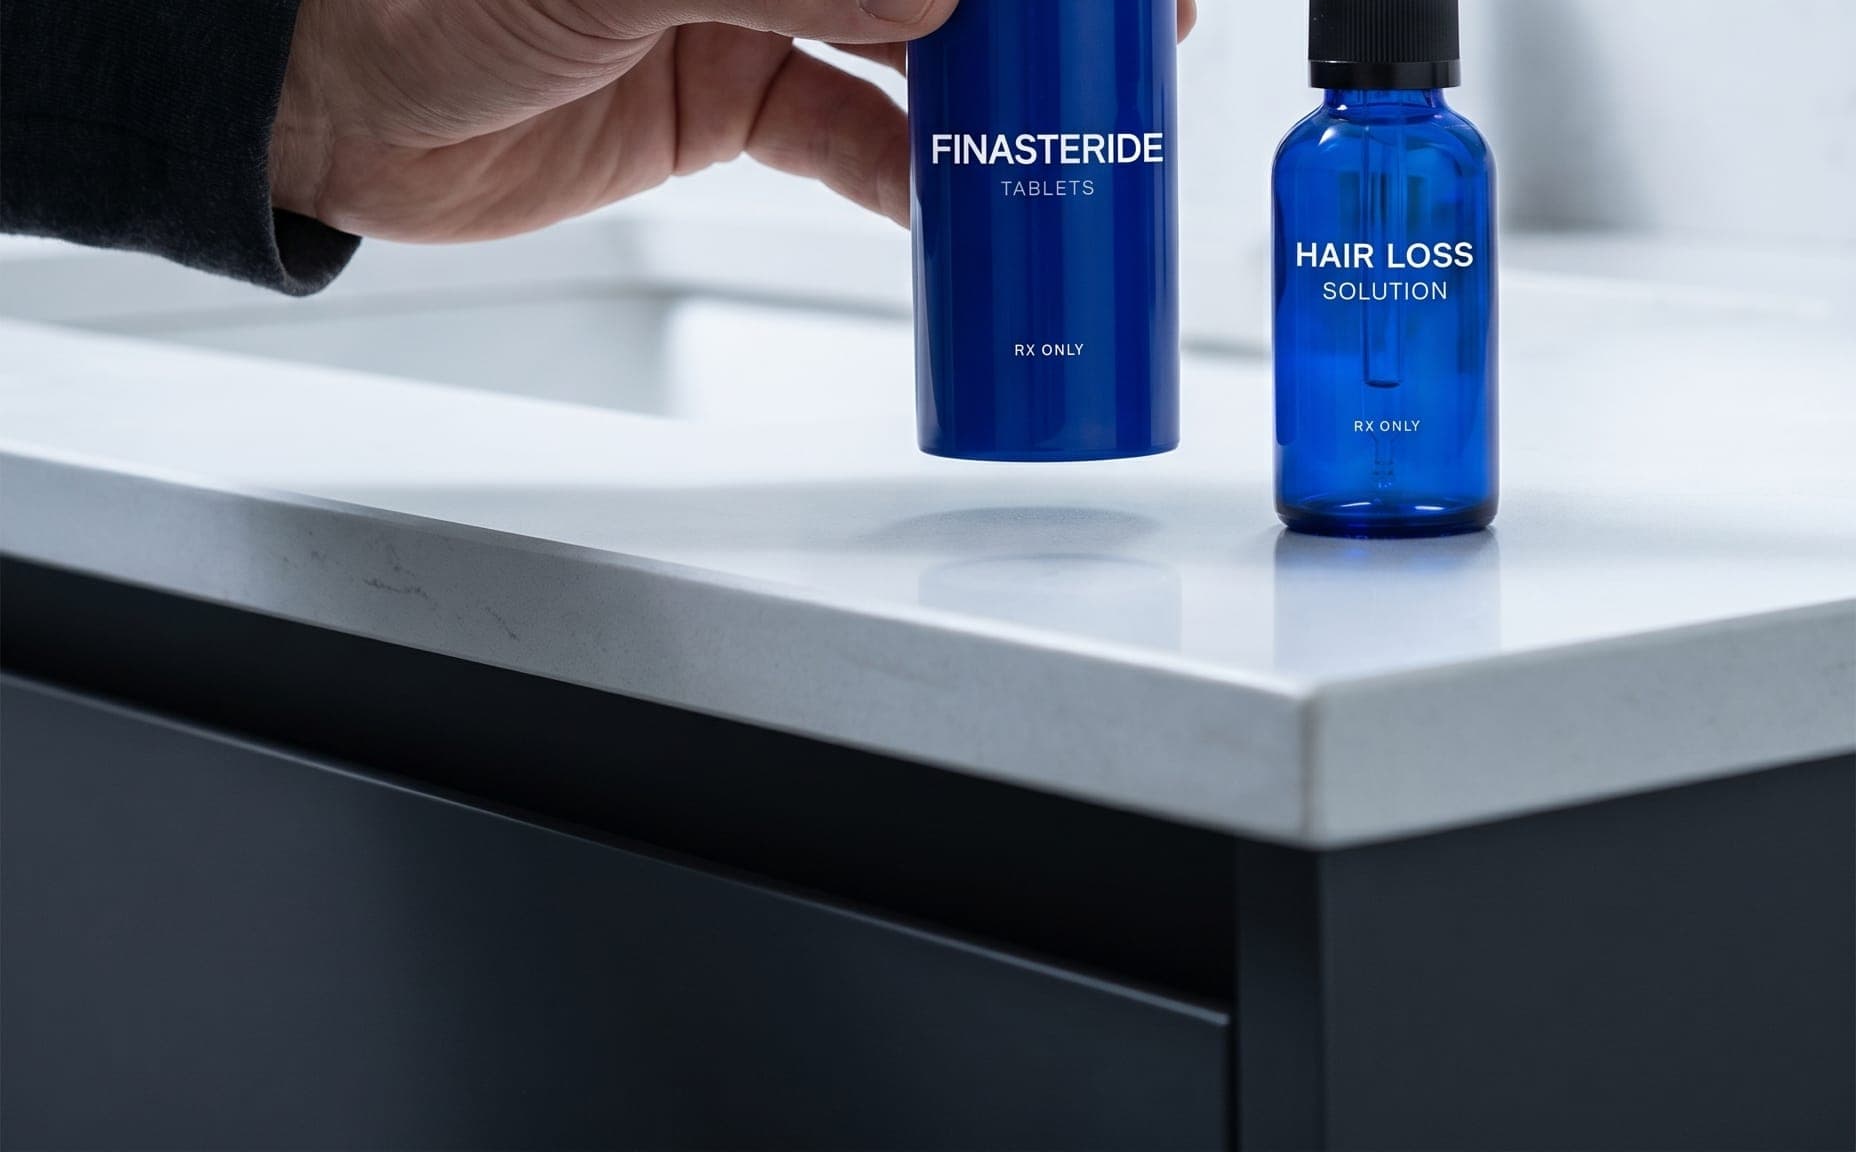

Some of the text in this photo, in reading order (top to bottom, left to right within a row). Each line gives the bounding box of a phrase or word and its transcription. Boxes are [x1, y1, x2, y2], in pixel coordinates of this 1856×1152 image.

[931, 133, 1164, 165] FINASTERIDE
[1001, 180, 1095, 196] TABLETS
[1296, 242, 1474, 268] HAIR LOSS
[1322, 282, 1447, 300] SOLUTION
[1014, 343, 1084, 356] RX ONLY
[1354, 420, 1421, 432] RX ONLY
